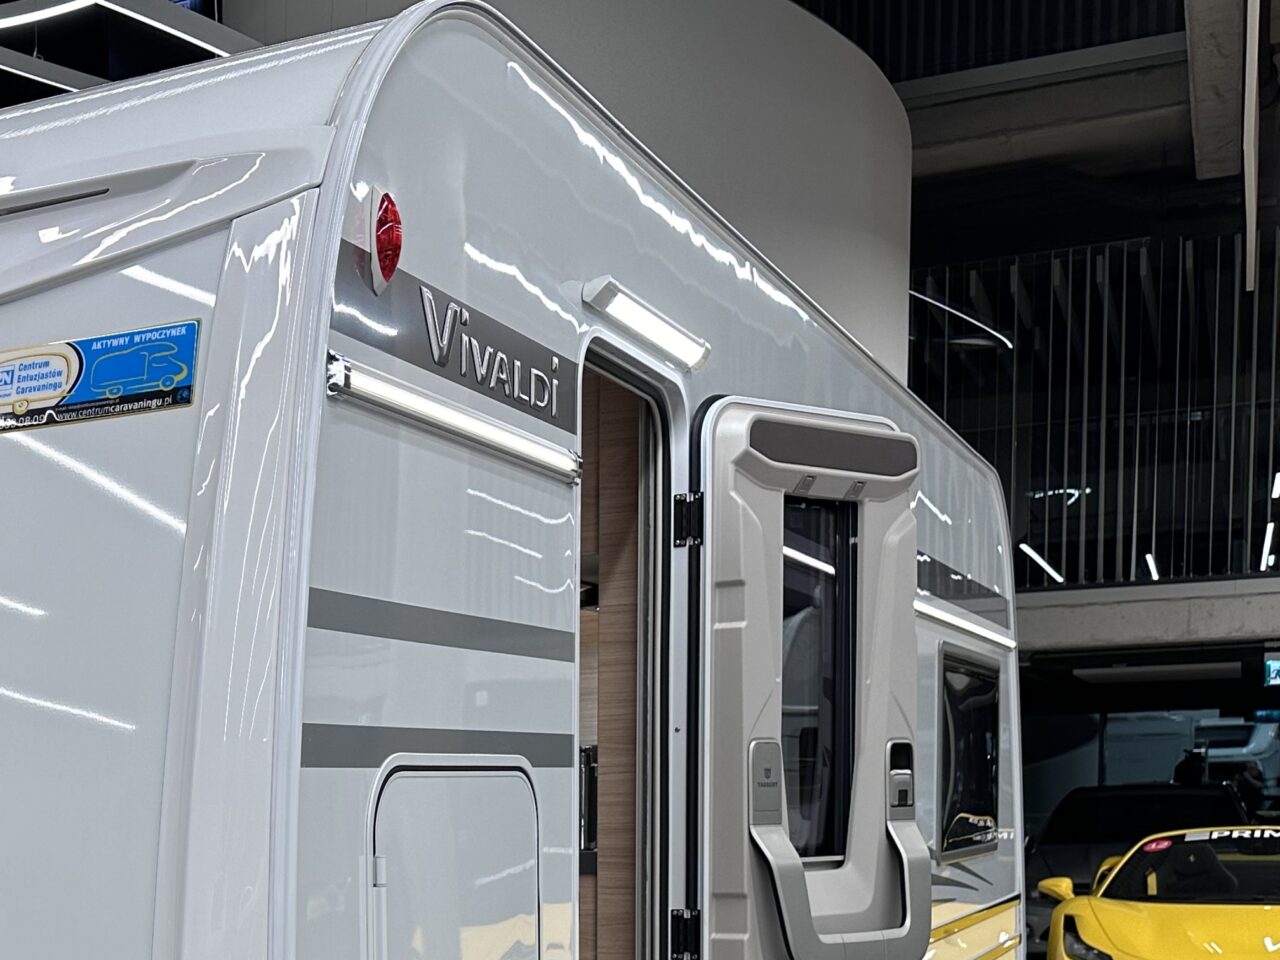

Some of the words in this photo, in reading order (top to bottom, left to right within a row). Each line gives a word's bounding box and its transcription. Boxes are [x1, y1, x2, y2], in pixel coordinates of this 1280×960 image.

[91, 336, 130, 351] AKTYWNY
[133, 326, 188, 342] WYPOCZYNEK
[18, 360, 50, 372] Centrum
[17, 369, 63, 384] Entuzjastów
[15, 382, 63, 395] Caravaningu
[57, 395, 173, 421] www.centrumcaravaningu.pl
